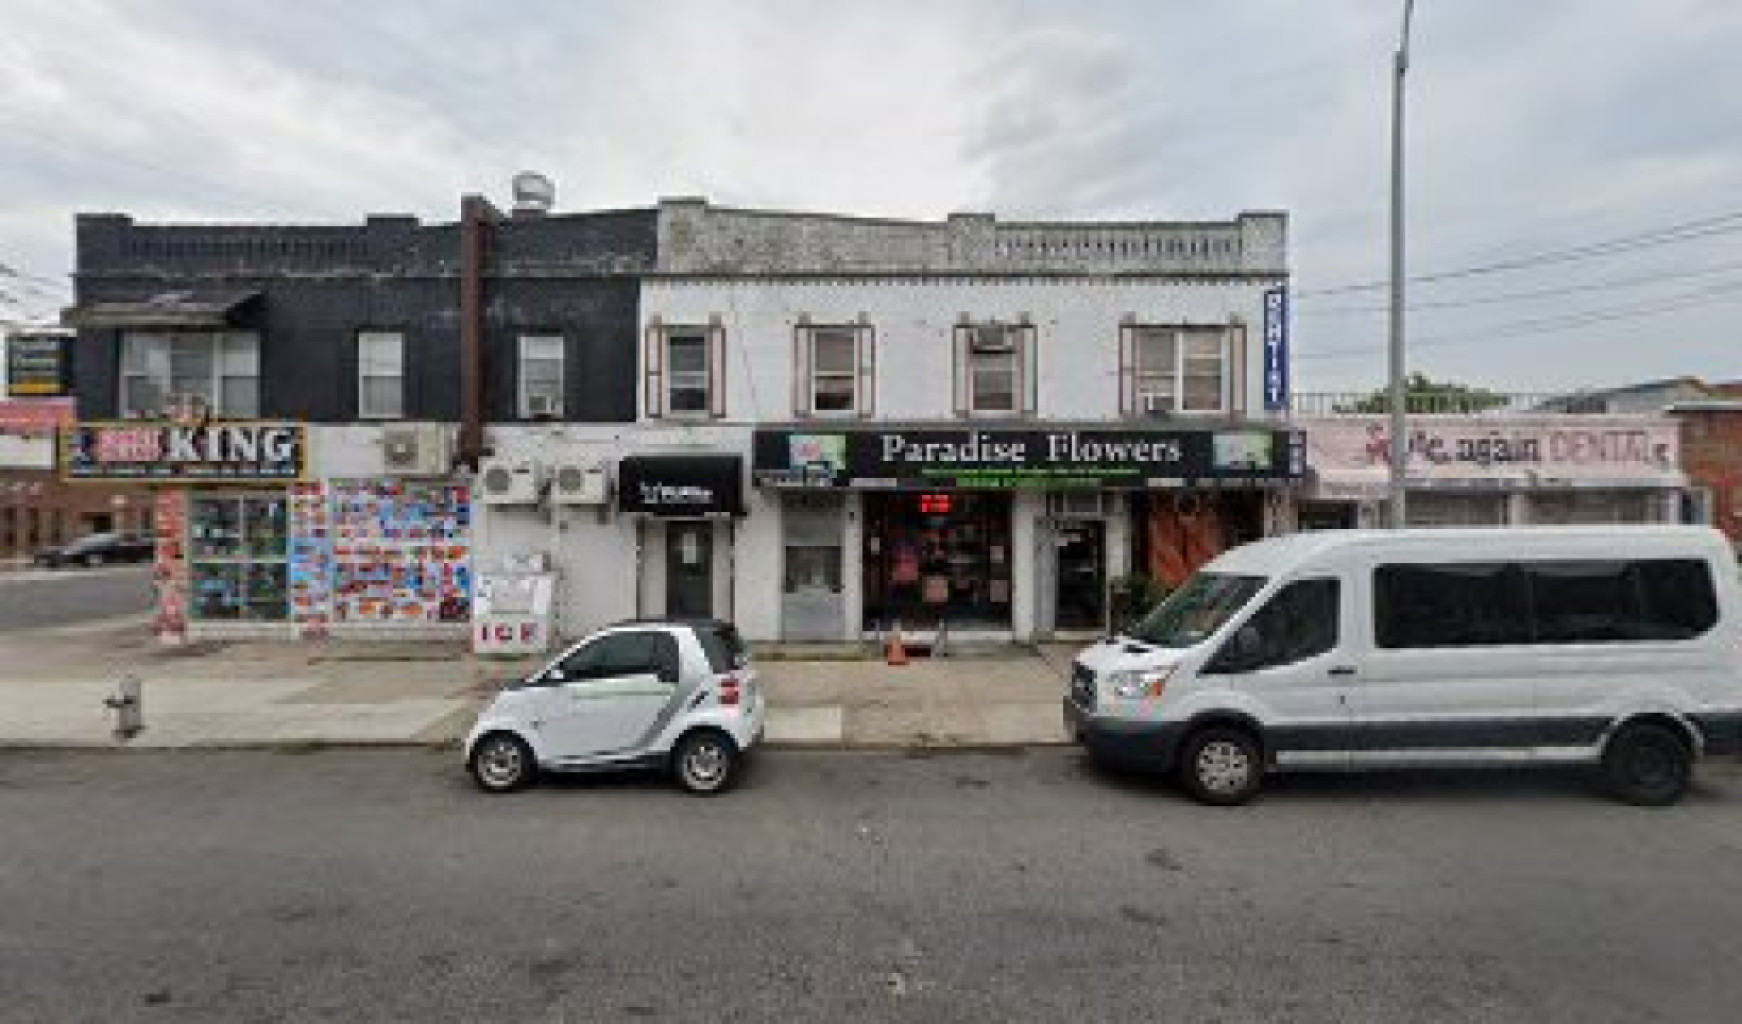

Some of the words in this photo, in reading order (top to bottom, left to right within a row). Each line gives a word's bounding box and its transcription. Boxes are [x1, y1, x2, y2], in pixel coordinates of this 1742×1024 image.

[167, 427, 293, 462] KING
[880, 430, 1027, 462] Paradise
[1046, 430, 1183, 462] Flowers
